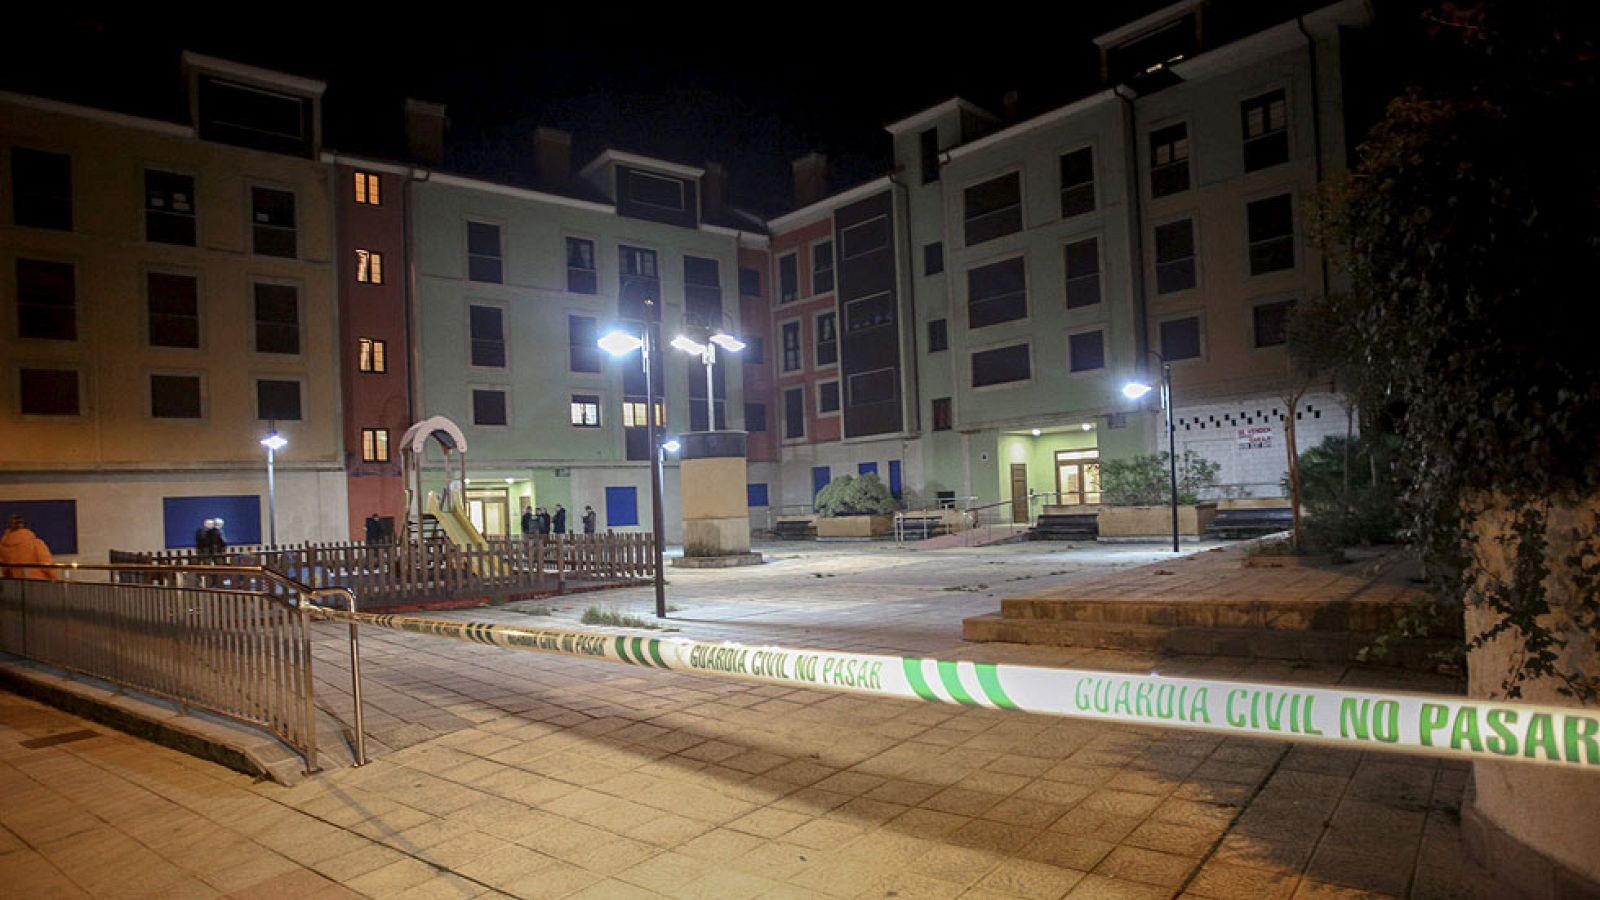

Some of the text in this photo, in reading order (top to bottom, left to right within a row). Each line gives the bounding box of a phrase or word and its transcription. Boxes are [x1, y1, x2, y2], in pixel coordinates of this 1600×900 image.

[690, 645, 883, 690] GUARDIA CIVIL NO PASAR
[1075, 676, 1600, 766] GUARDIA CIVIL NO PASAR
